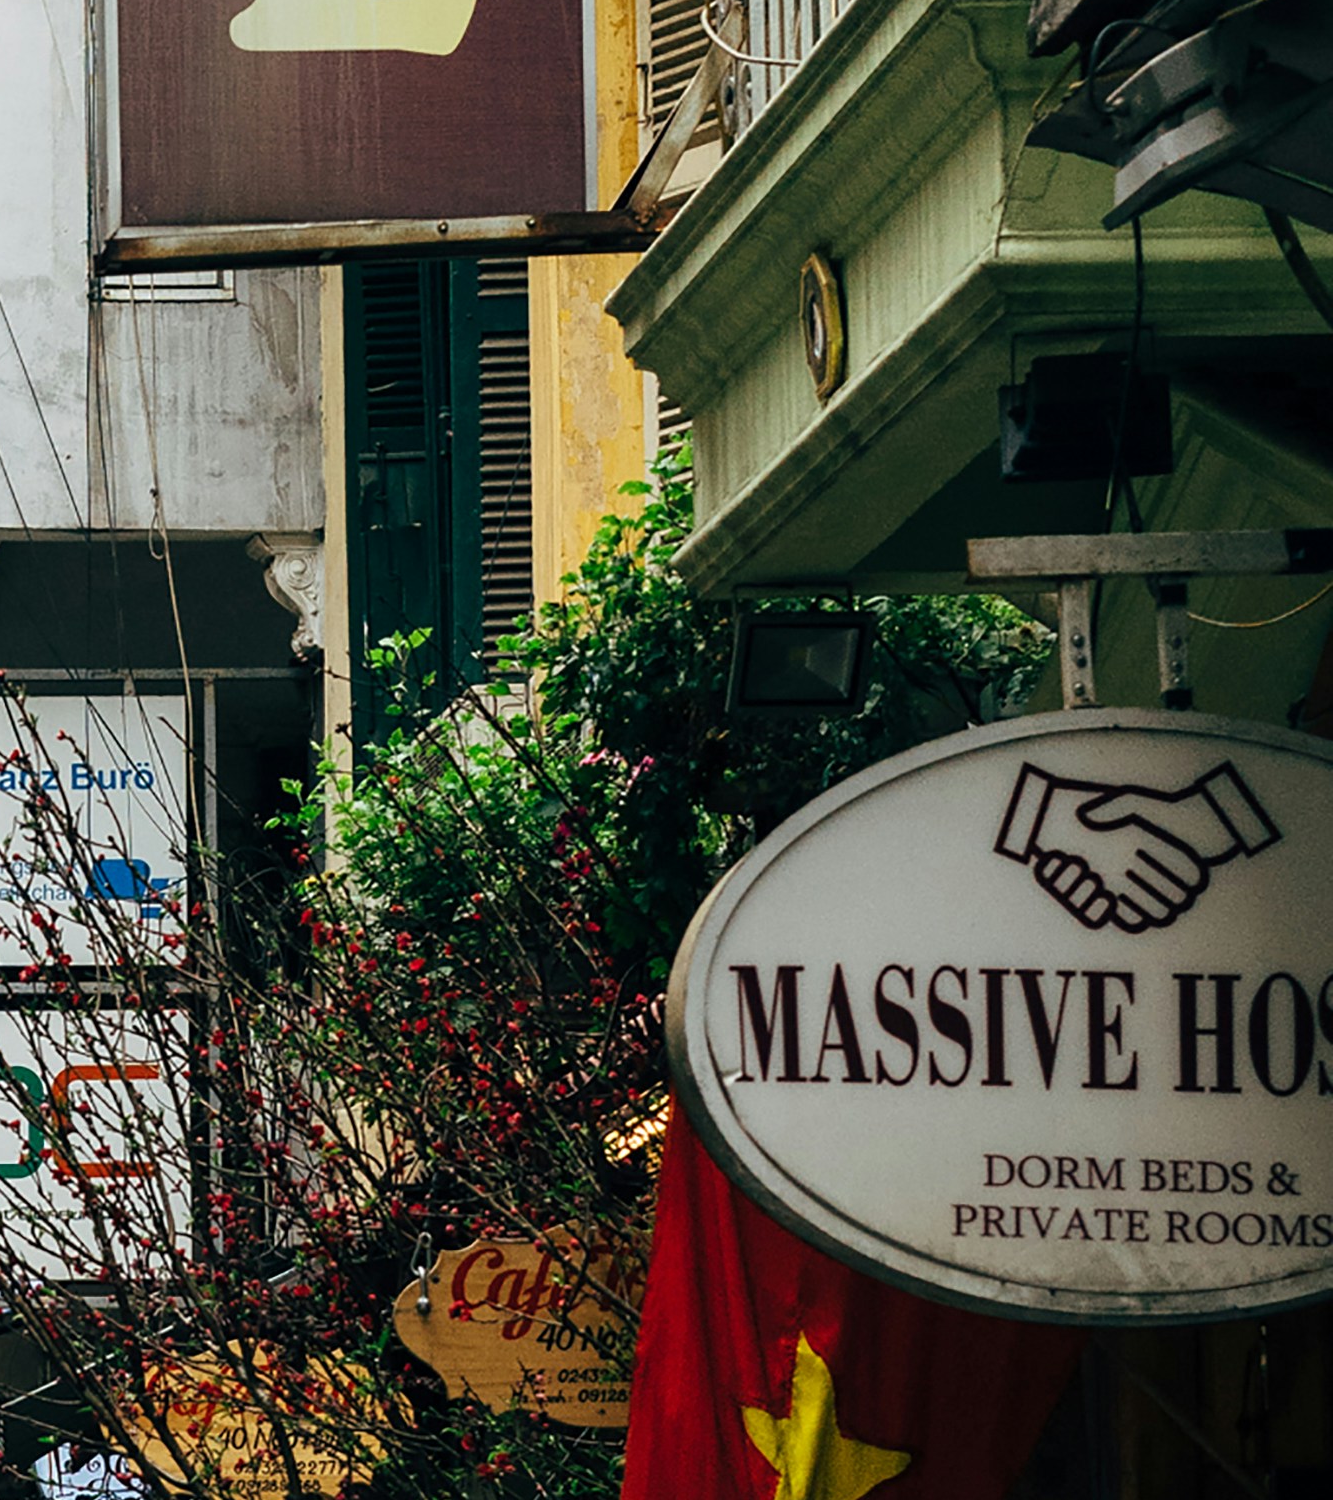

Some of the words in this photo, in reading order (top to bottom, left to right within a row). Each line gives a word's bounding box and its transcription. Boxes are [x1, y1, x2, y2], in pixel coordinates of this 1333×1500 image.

[70, 761, 155, 792] Burö
[729, 963, 1139, 1093] MASSIVE
[983, 1154, 1127, 1191] DORM
[1140, 1158, 1254, 1196] BEDS
[1266, 1161, 1301, 1196] &
[951, 1204, 1151, 1242] PRIVATE
[1164, 1208, 1333, 1248] ROOMS
